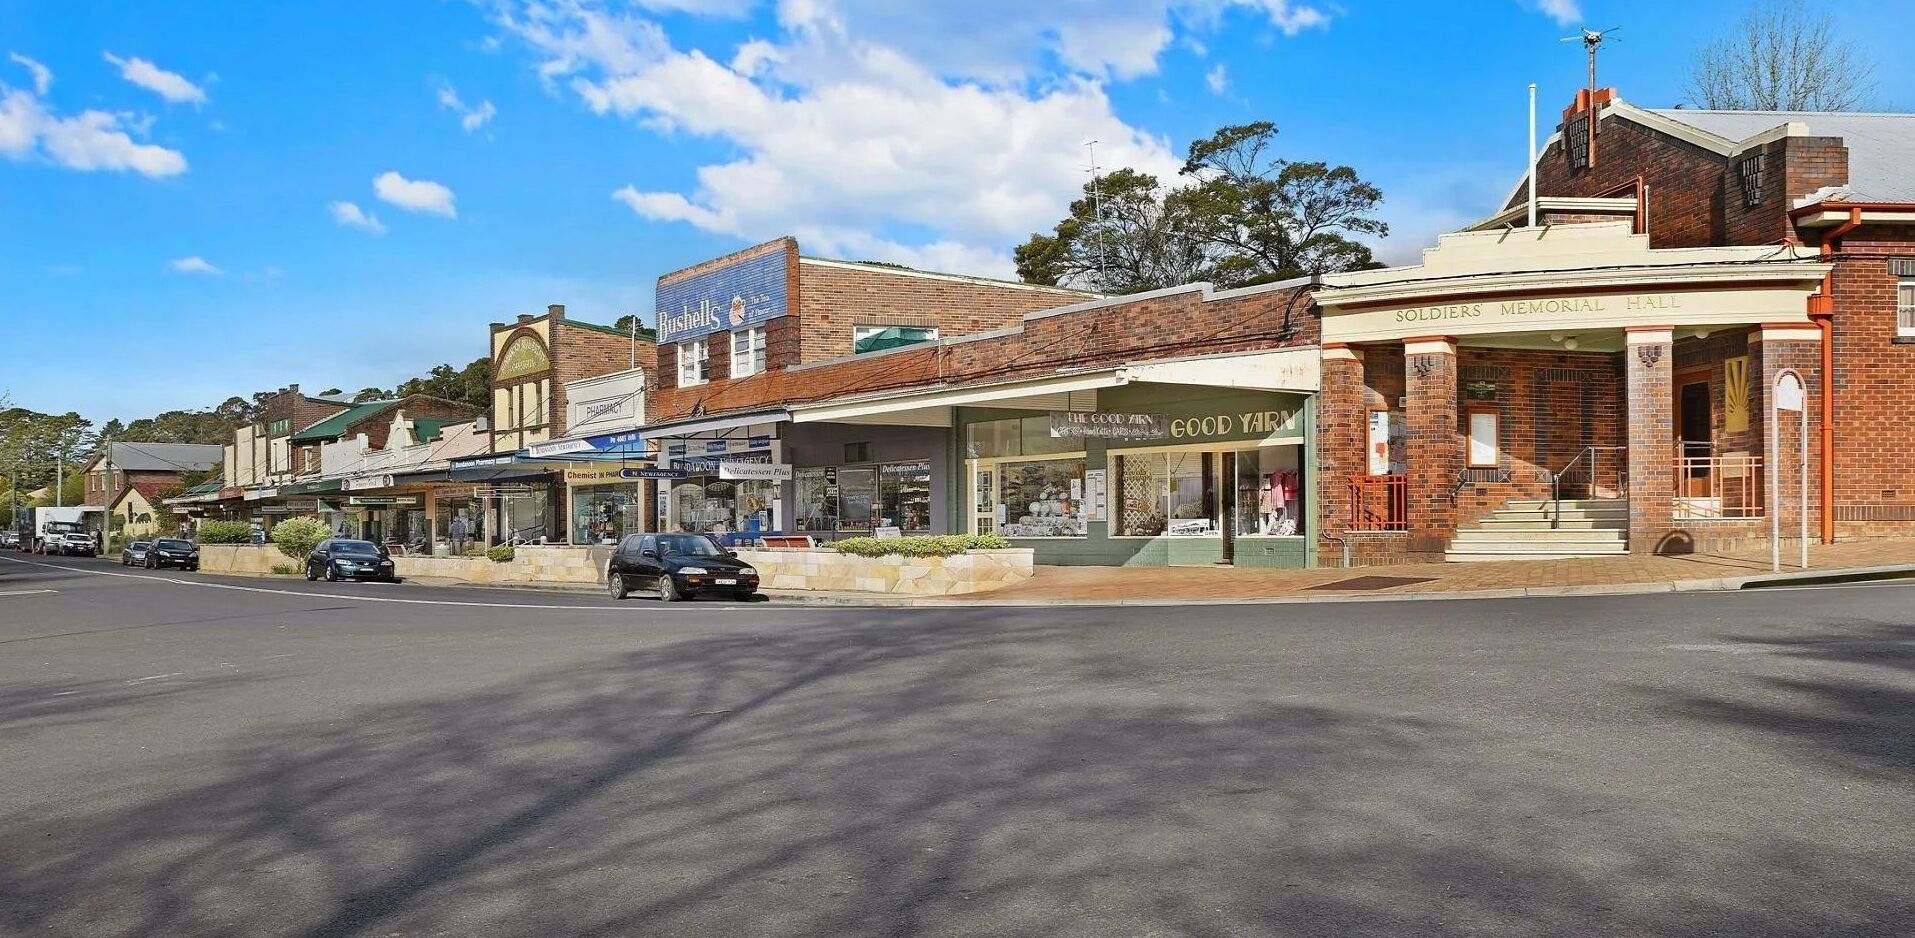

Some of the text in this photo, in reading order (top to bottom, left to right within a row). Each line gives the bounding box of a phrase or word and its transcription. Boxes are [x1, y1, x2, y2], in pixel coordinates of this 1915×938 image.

[1501, 299, 1606, 315] MEMORIAL
[1626, 295, 1681, 310] HALL
[659, 299, 721, 343] Bushells
[587, 402, 623, 419] PHARMACY
[1068, 412, 1087, 423] THE
[1091, 413, 1125, 424] GOOD
[1171, 410, 1296, 438] GOOD YARN
[567, 471, 597, 479] Chemist
[724, 466, 791, 477] Delicatessen Plus
[882, 462, 931, 474] Delicatessen Plus
